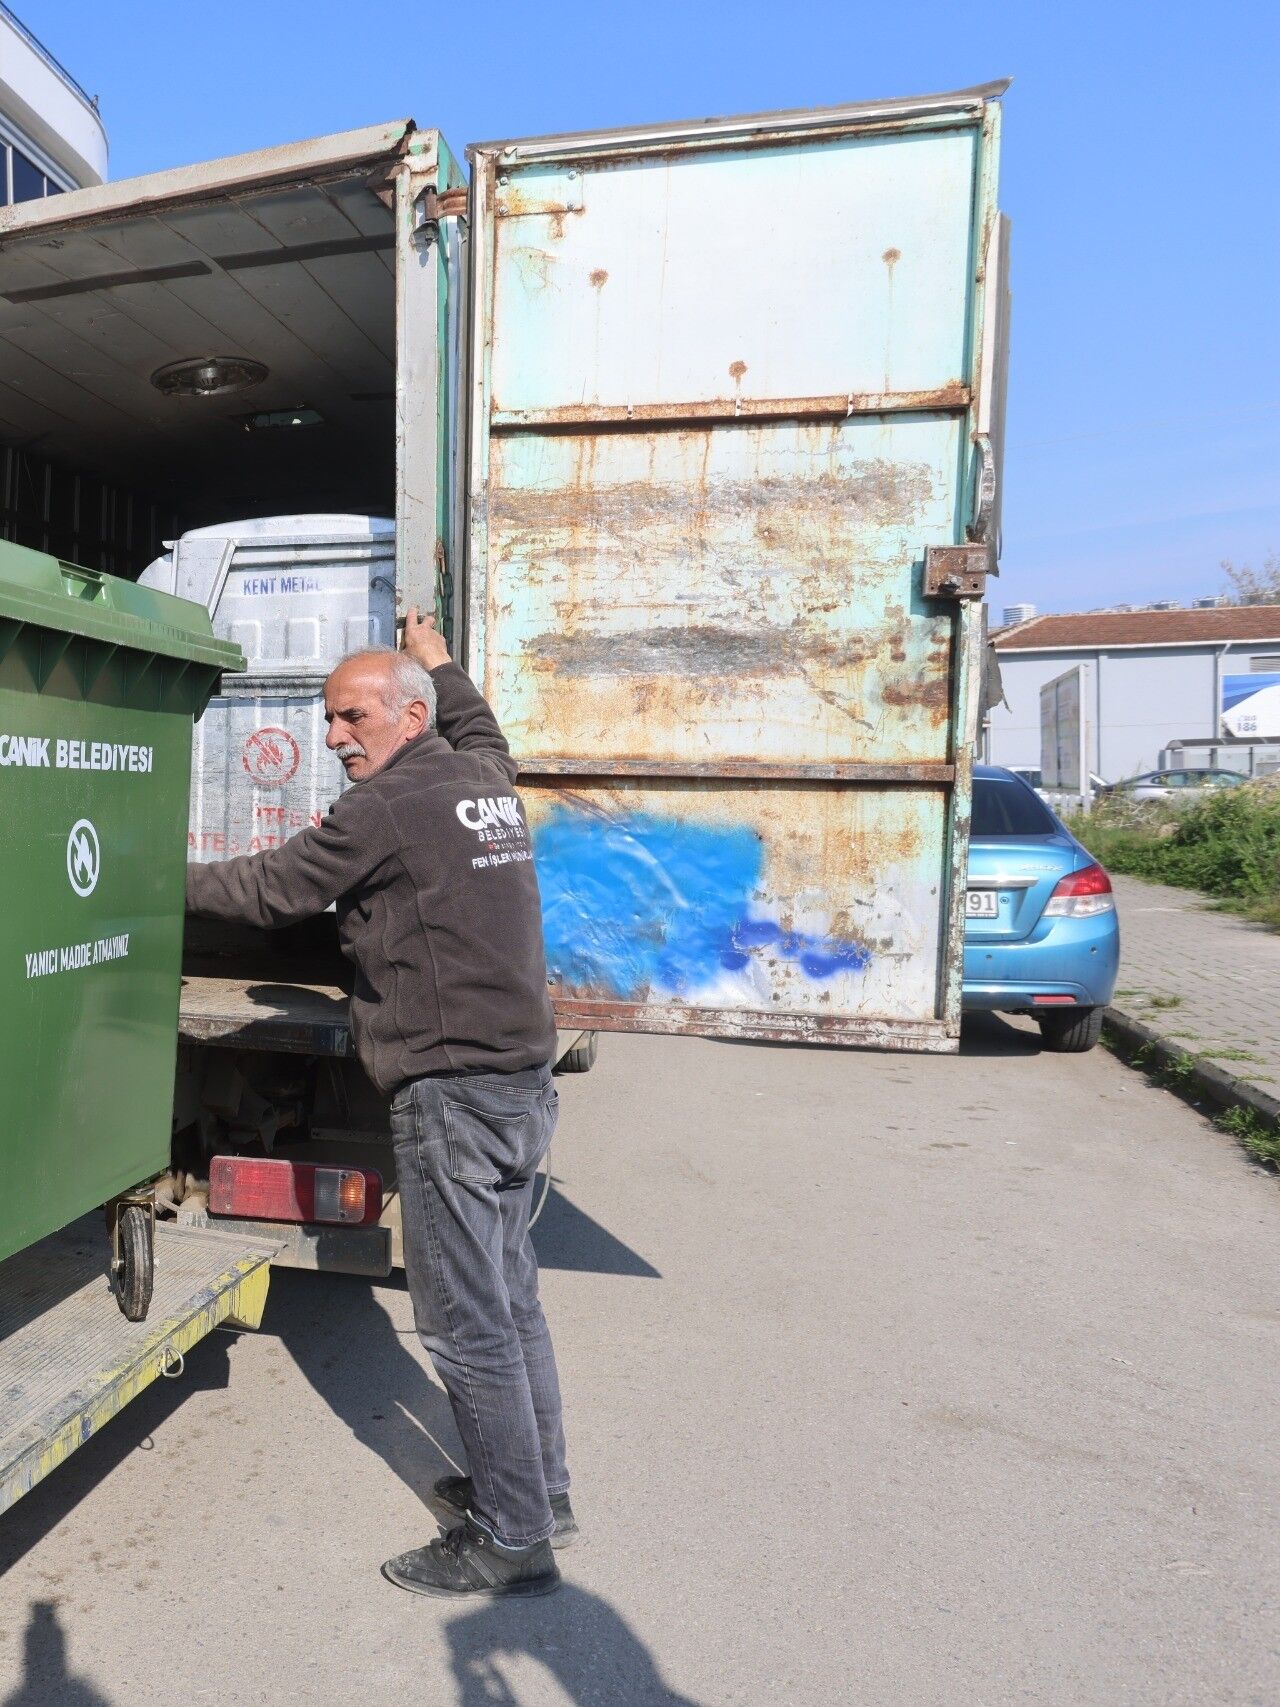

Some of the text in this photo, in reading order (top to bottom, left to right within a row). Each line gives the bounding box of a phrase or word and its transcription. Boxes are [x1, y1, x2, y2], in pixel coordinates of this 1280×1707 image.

[243, 577, 276, 596] KENT
[472, 855, 490, 870] FEN
[25, 933, 130, 979] YANICI MADDE ATMAYINIZ
